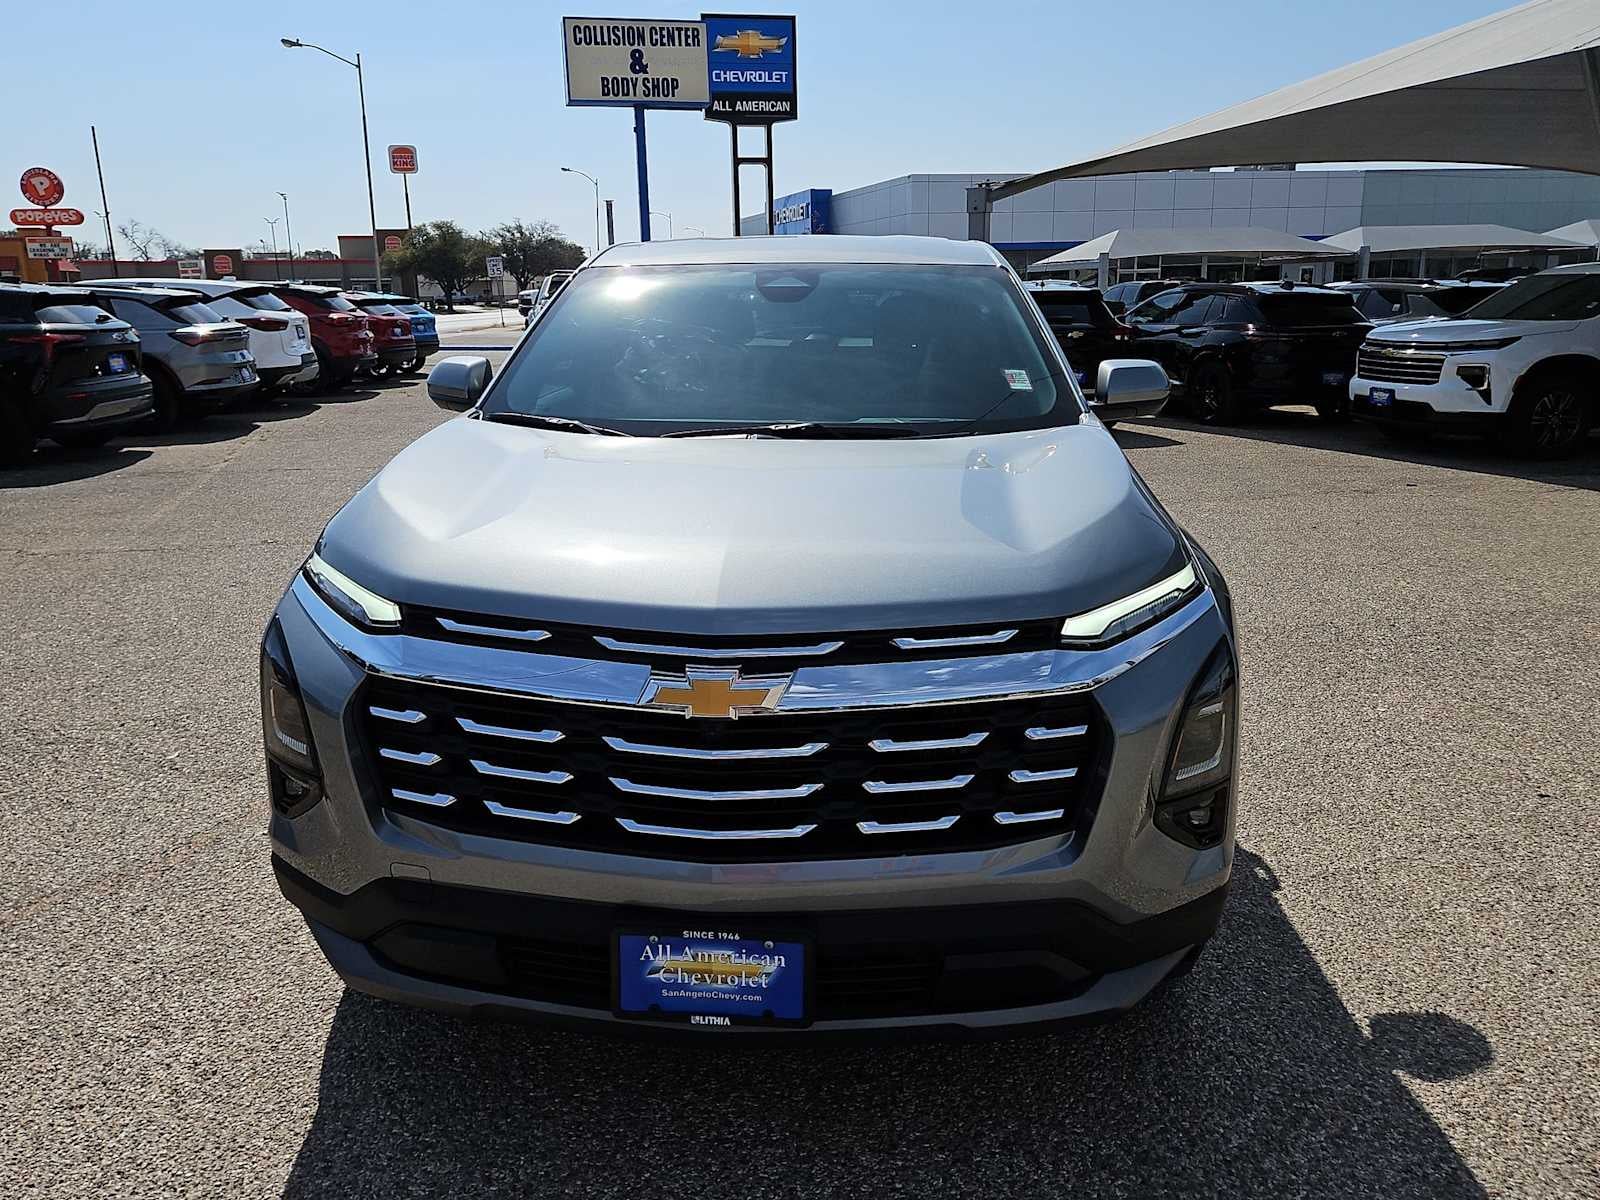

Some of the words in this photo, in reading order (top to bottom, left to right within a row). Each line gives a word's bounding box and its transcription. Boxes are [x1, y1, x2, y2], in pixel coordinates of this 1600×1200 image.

[573, 24, 646, 47] COLLISION
[649, 26, 701, 48] CENTER
[629, 48, 649, 75] &
[712, 69, 788, 83] CHEVROLET
[601, 76, 639, 98] BODY
[642, 77, 680, 98] SHOP
[712, 100, 733, 112] ALL
[735, 100, 791, 112] AMERICAN
[392, 159, 415, 167] KING
[30, 176, 50, 197] P
[775, 203, 808, 225] CHEVROLET
[490, 267, 502, 275] 35
[682, 930, 715, 939] SINCE
[717, 932, 741, 941] 1946
[639, 944, 672, 962] All
[682, 945, 786, 968] American
[659, 966, 770, 989] Chevrolet
[661, 988, 763, 1002] SanAngeloChevy.com
[699, 1016, 731, 1026] LITHIA
